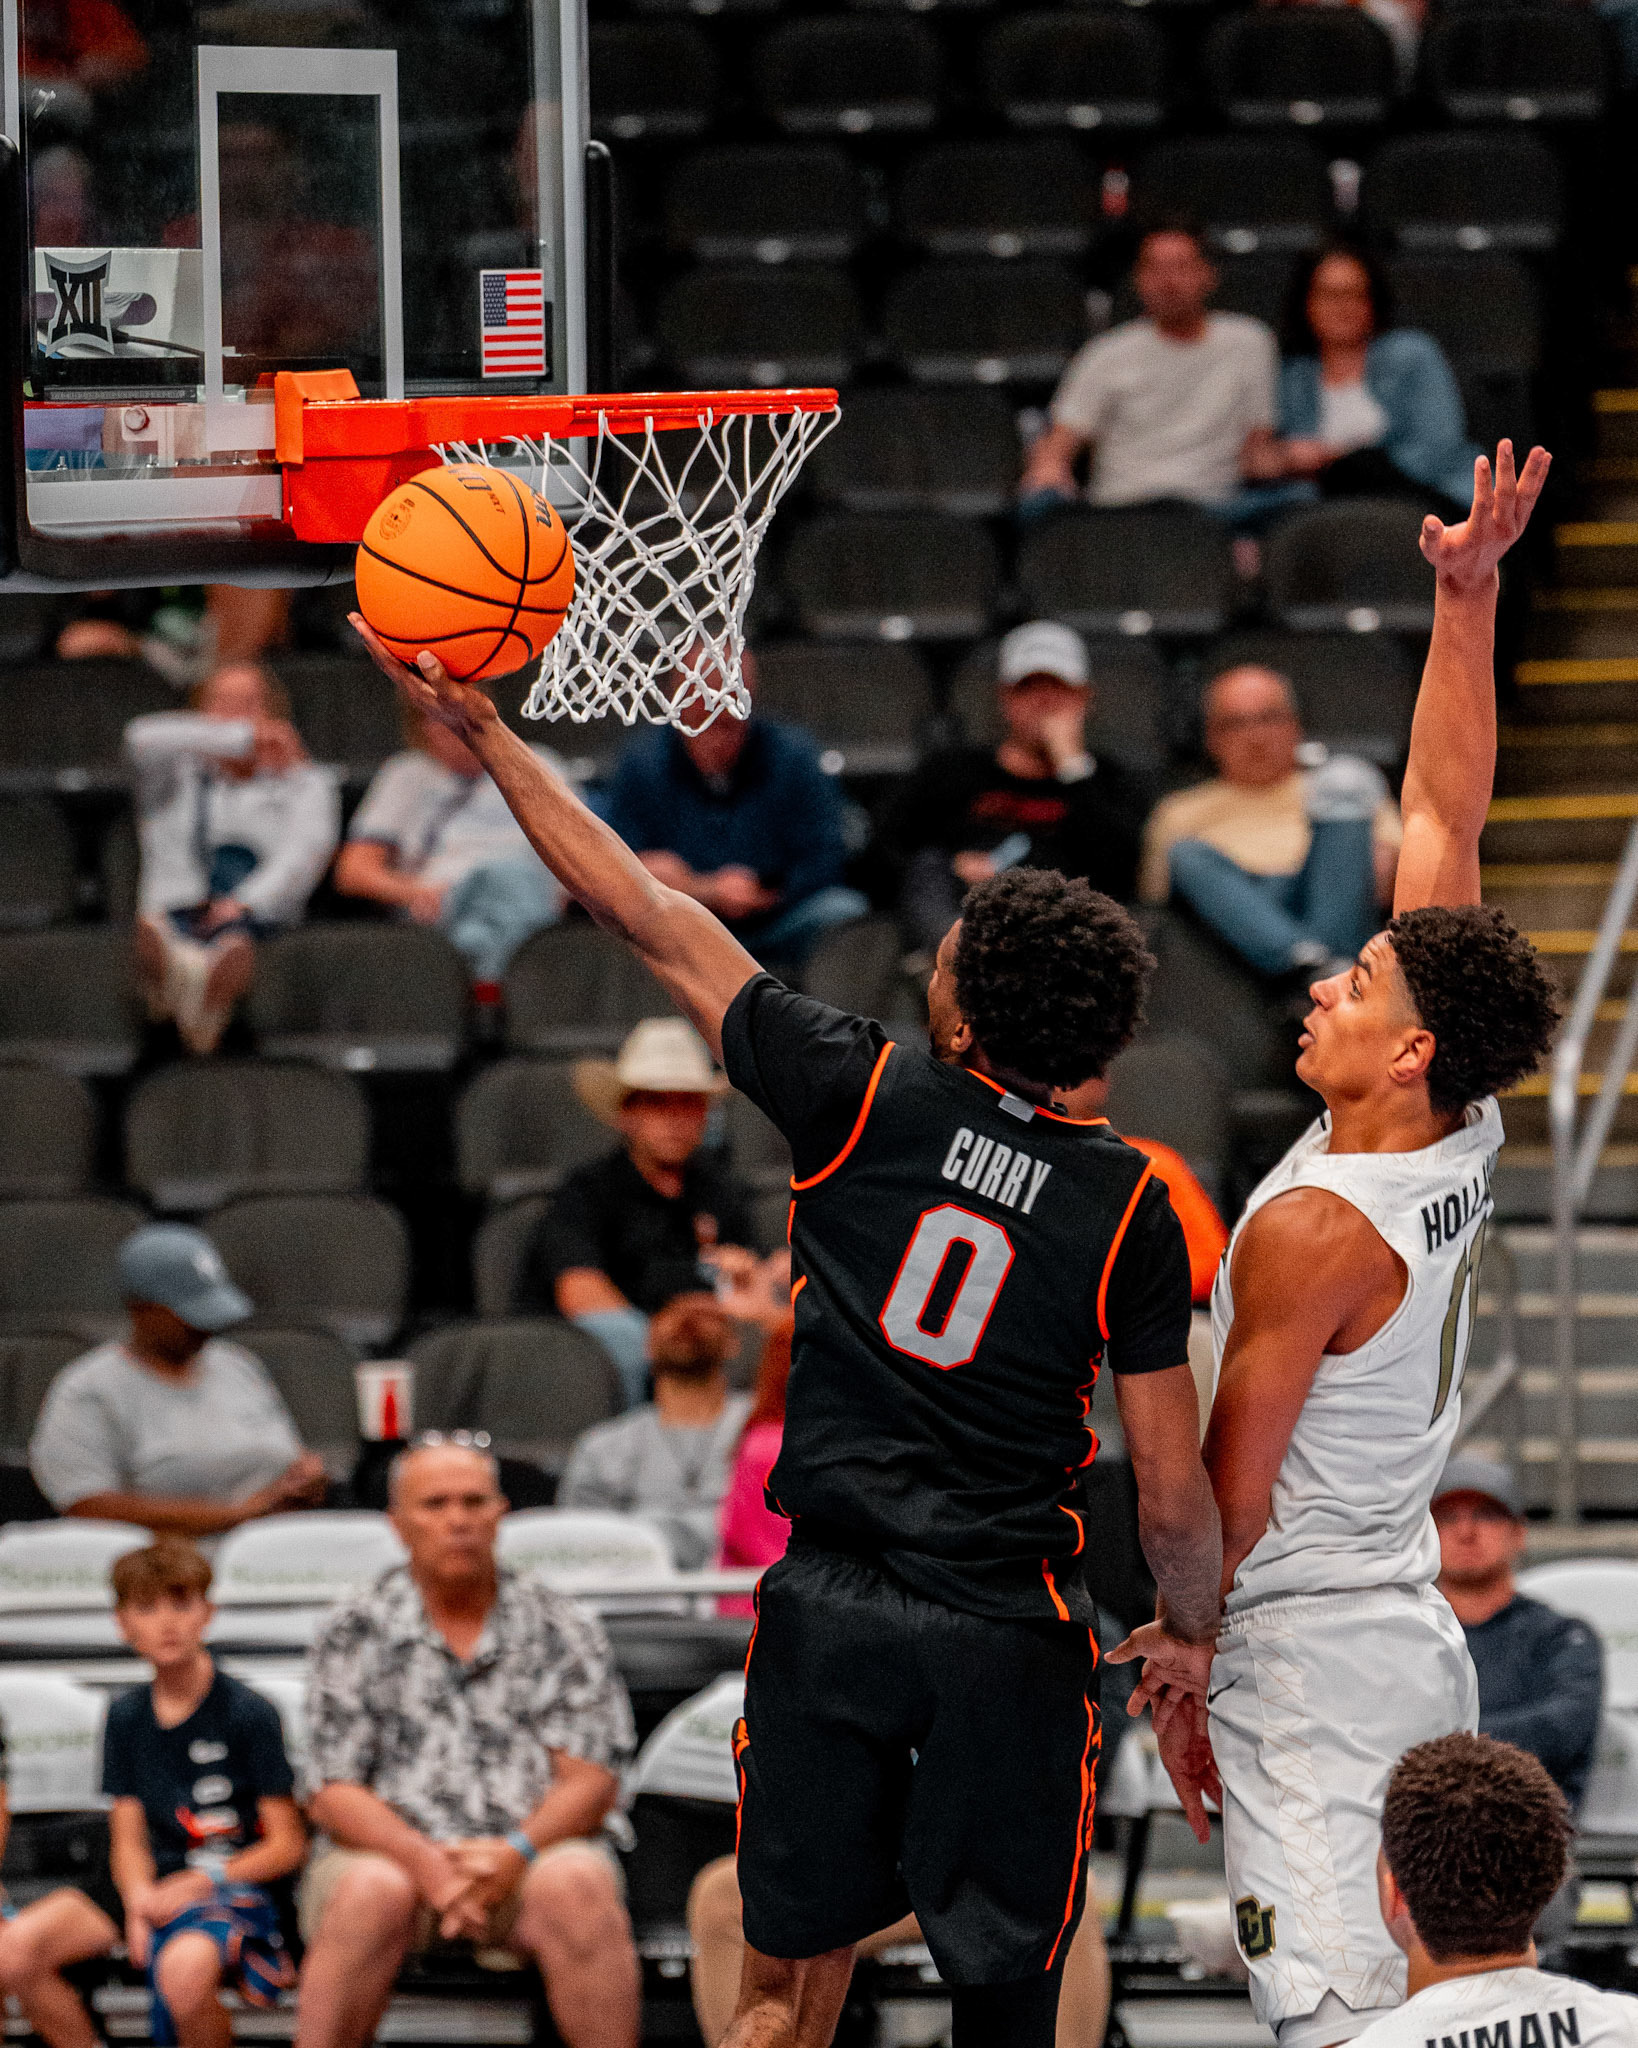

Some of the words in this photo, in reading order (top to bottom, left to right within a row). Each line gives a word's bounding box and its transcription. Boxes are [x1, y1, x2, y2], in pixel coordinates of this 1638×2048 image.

[48, 258, 111, 345] XII
[941, 1127, 1053, 1215] CURRY
[878, 1202, 1017, 1371] 0
[1236, 1896, 1276, 1961] CU
[1425, 2007, 1581, 2048] MAN
